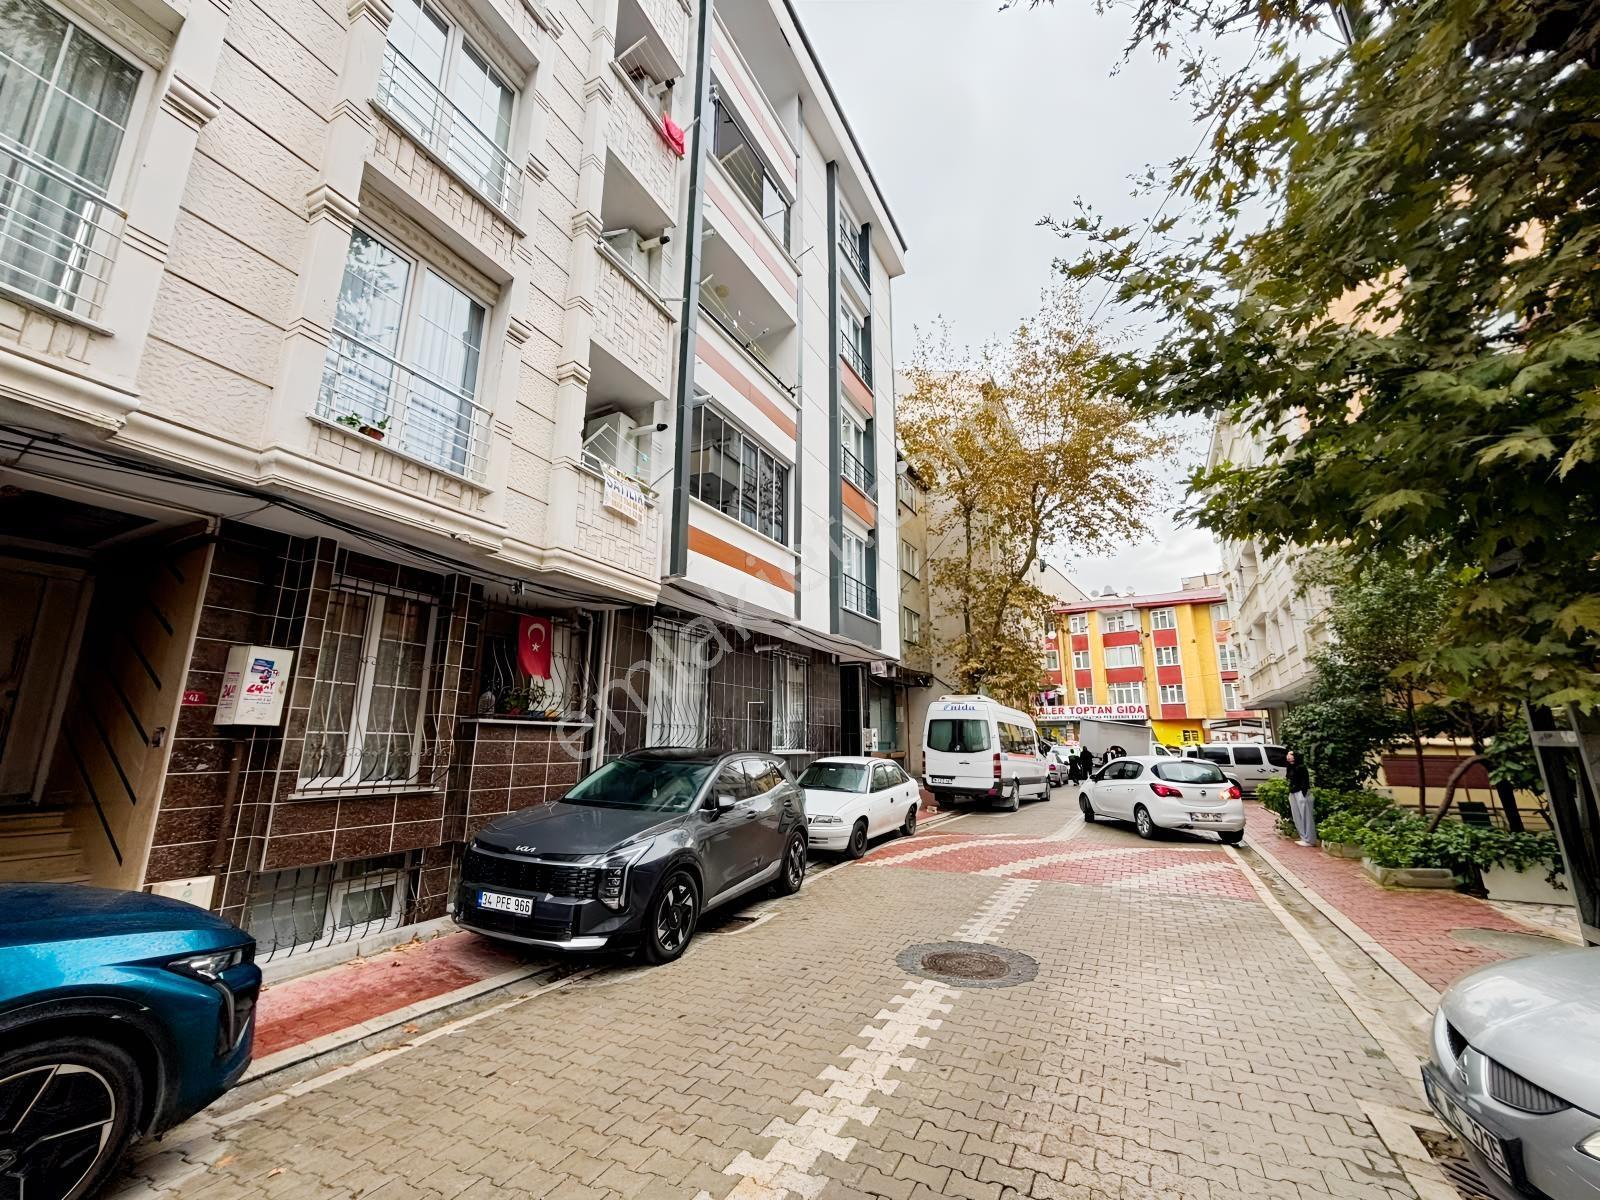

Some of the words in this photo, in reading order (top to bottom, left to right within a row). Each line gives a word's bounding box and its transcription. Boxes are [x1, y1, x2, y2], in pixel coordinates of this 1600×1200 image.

[1069, 705, 1113, 715] TOPTAN
[1117, 705, 1144, 714] GIDA
[483, 893, 492, 905] 34
[496, 895, 512, 910] PFE
[514, 898, 530, 913] 966
